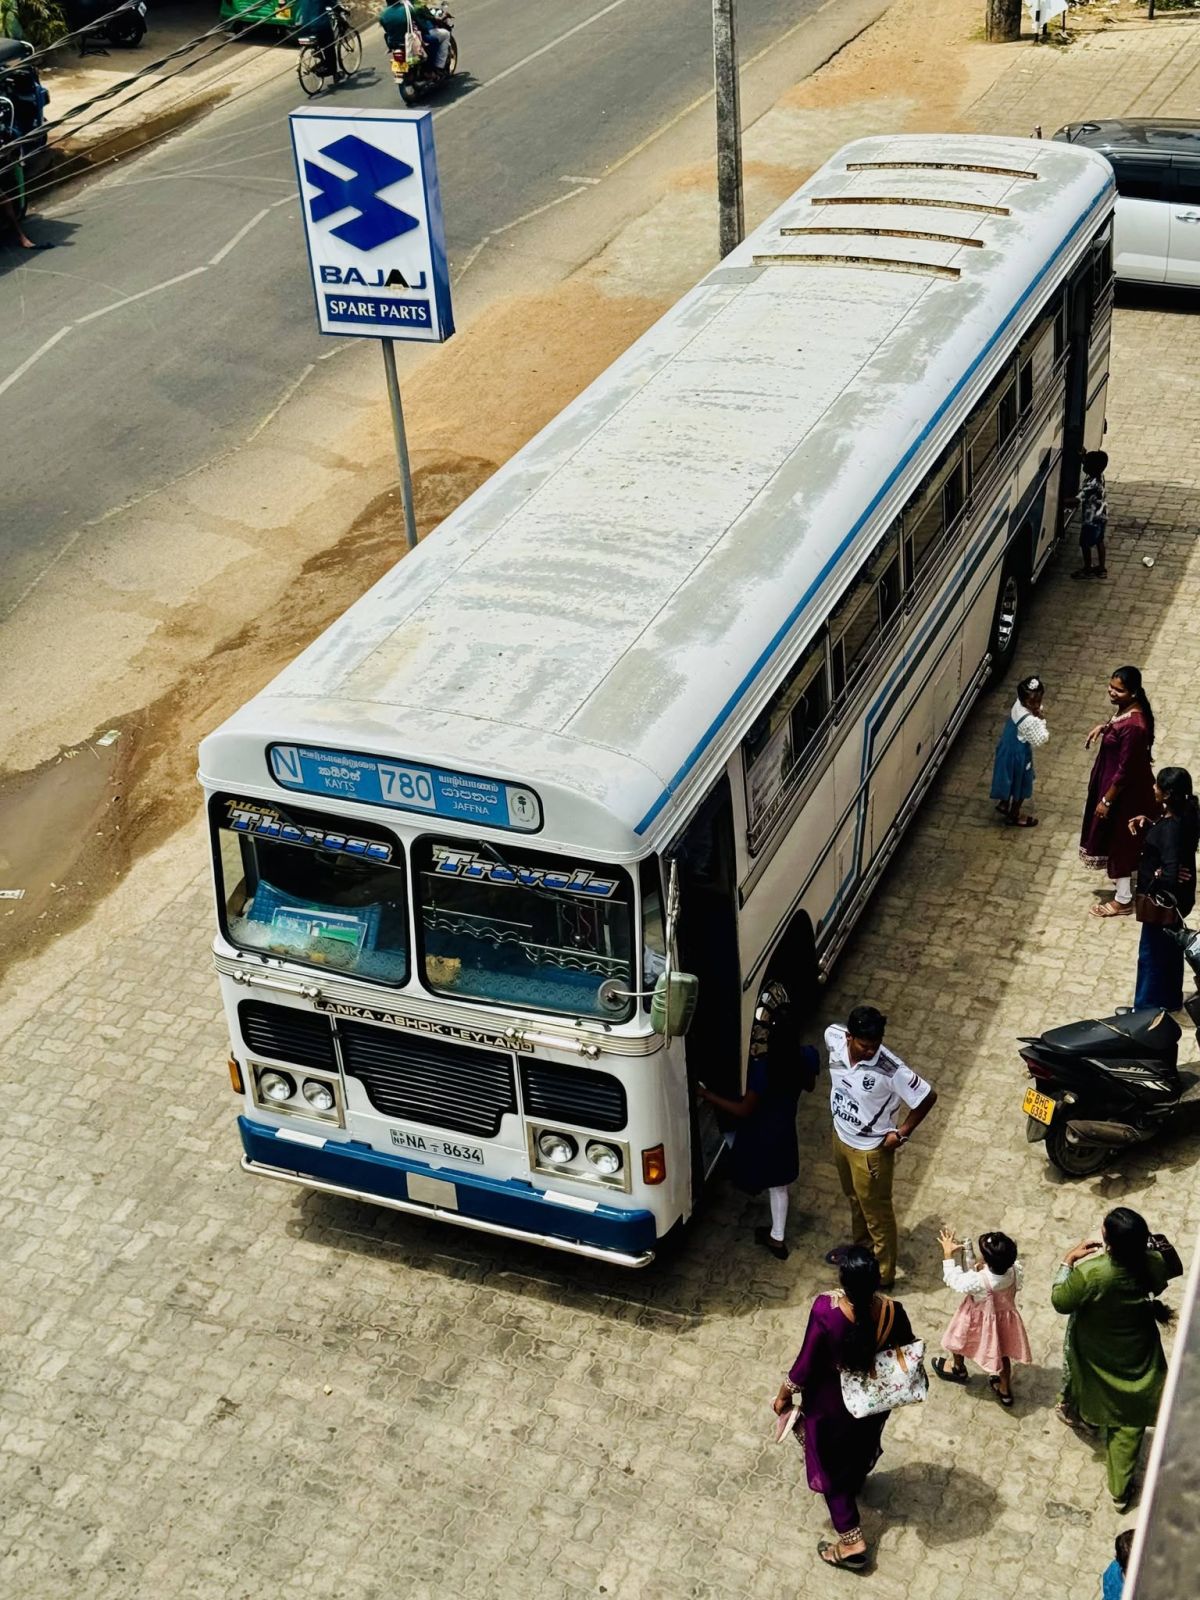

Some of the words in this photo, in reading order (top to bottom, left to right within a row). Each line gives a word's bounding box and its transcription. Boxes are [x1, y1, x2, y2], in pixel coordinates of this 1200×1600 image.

[320, 266, 427, 290] BAJAJ
[330, 300, 376, 317] SPARE
[380, 304, 427, 321] PARTS
[272, 748, 299, 778] N
[325, 778, 356, 792] KAYTS
[380, 769, 432, 802] 780
[452, 801, 490, 815] JAFFNA
[229, 808, 391, 861] Theresa
[433, 846, 619, 896] Travels
[313, 1001, 374, 1020] LANKA
[382, 1014, 443, 1033] ASHOK
[450, 1027, 534, 1052] LEYLAND
